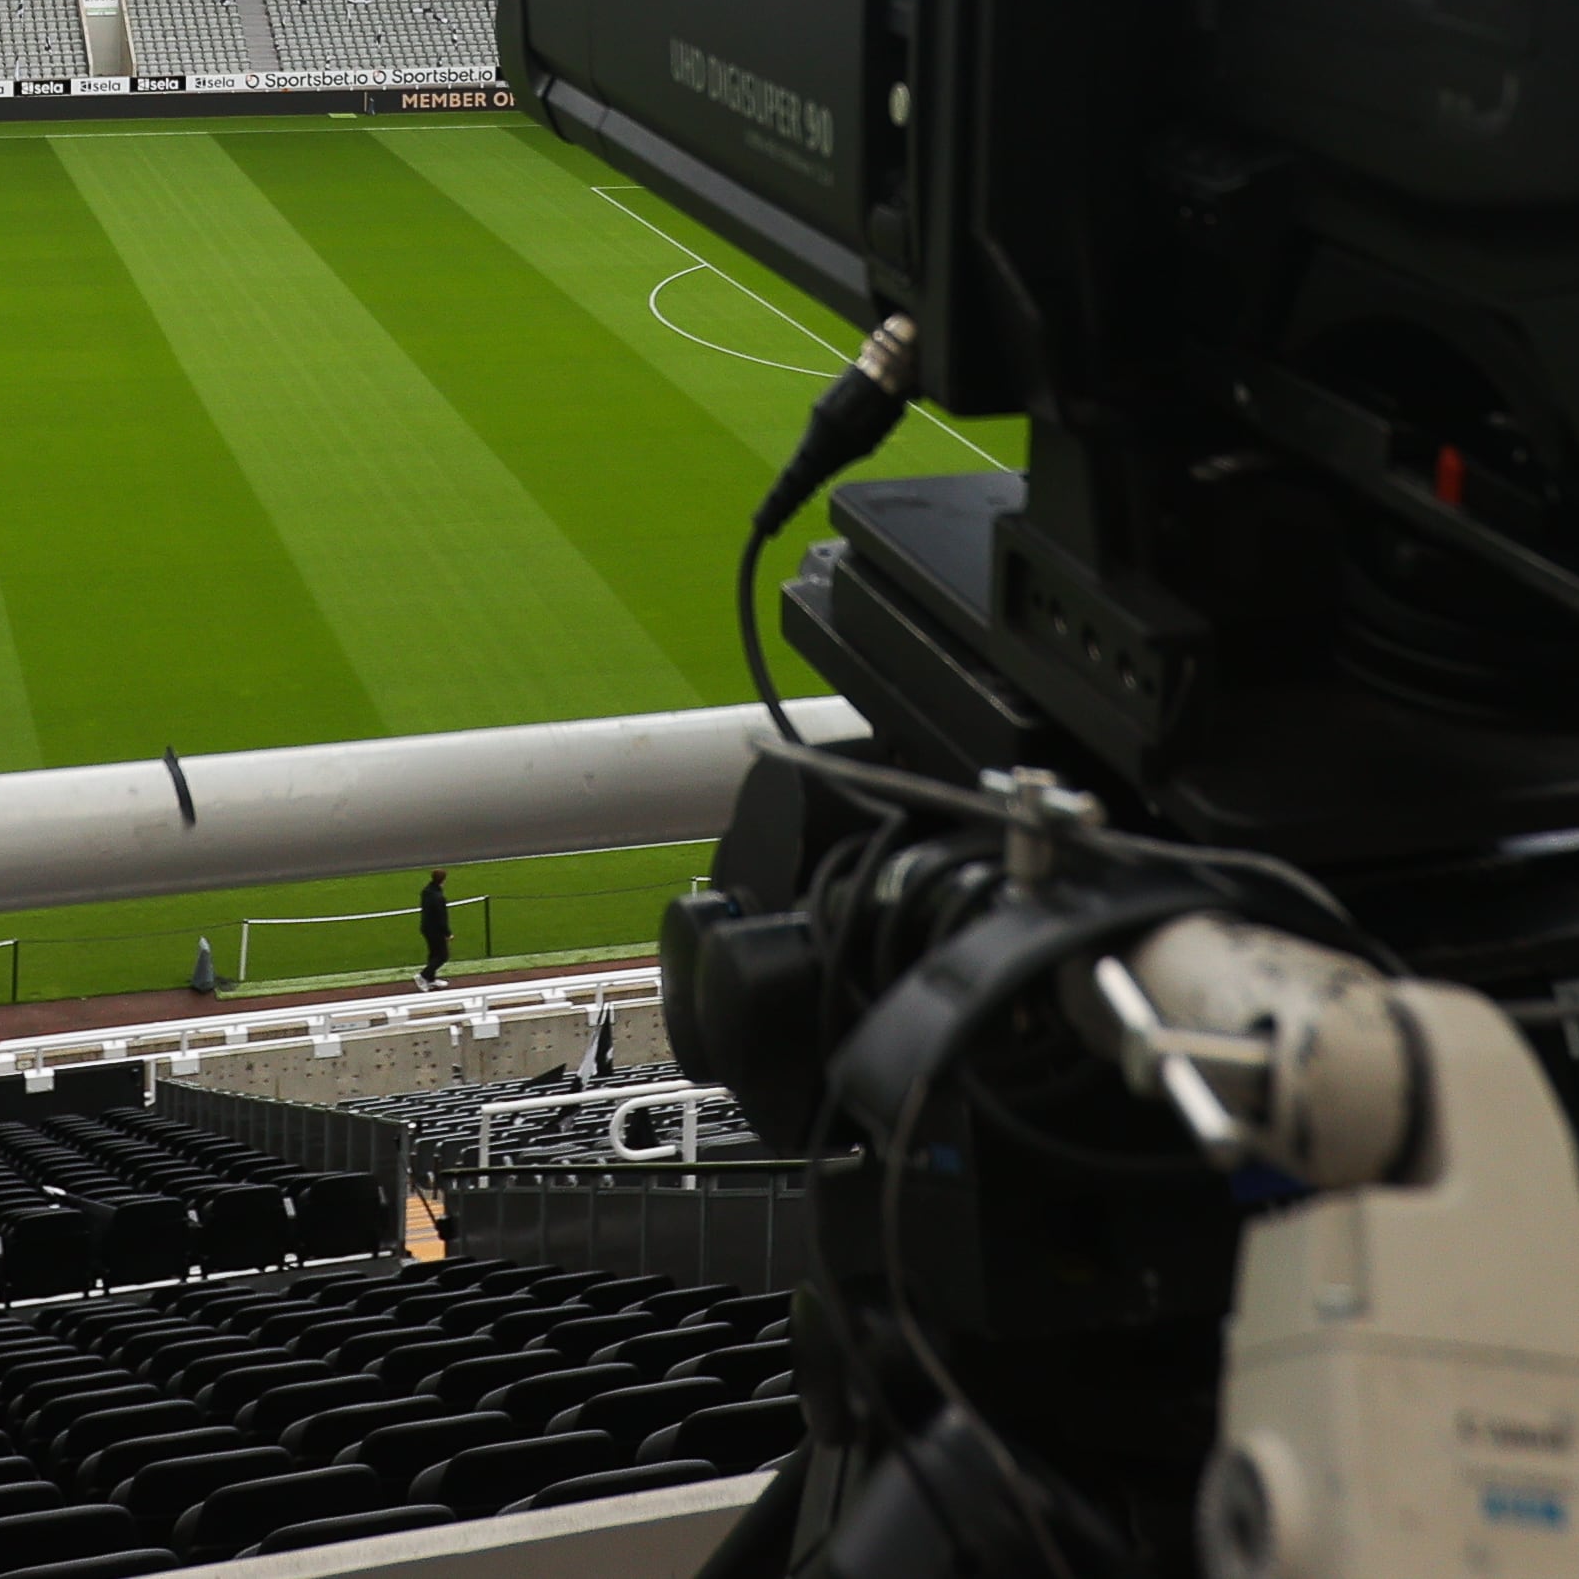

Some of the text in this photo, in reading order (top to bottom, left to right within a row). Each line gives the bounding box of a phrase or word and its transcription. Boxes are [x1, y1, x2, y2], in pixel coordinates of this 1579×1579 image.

[265, 69, 368, 88] Sportsbet.io
[392, 67, 492, 84] Sportsbet.io
[402, 92, 487, 109] MEMBER
